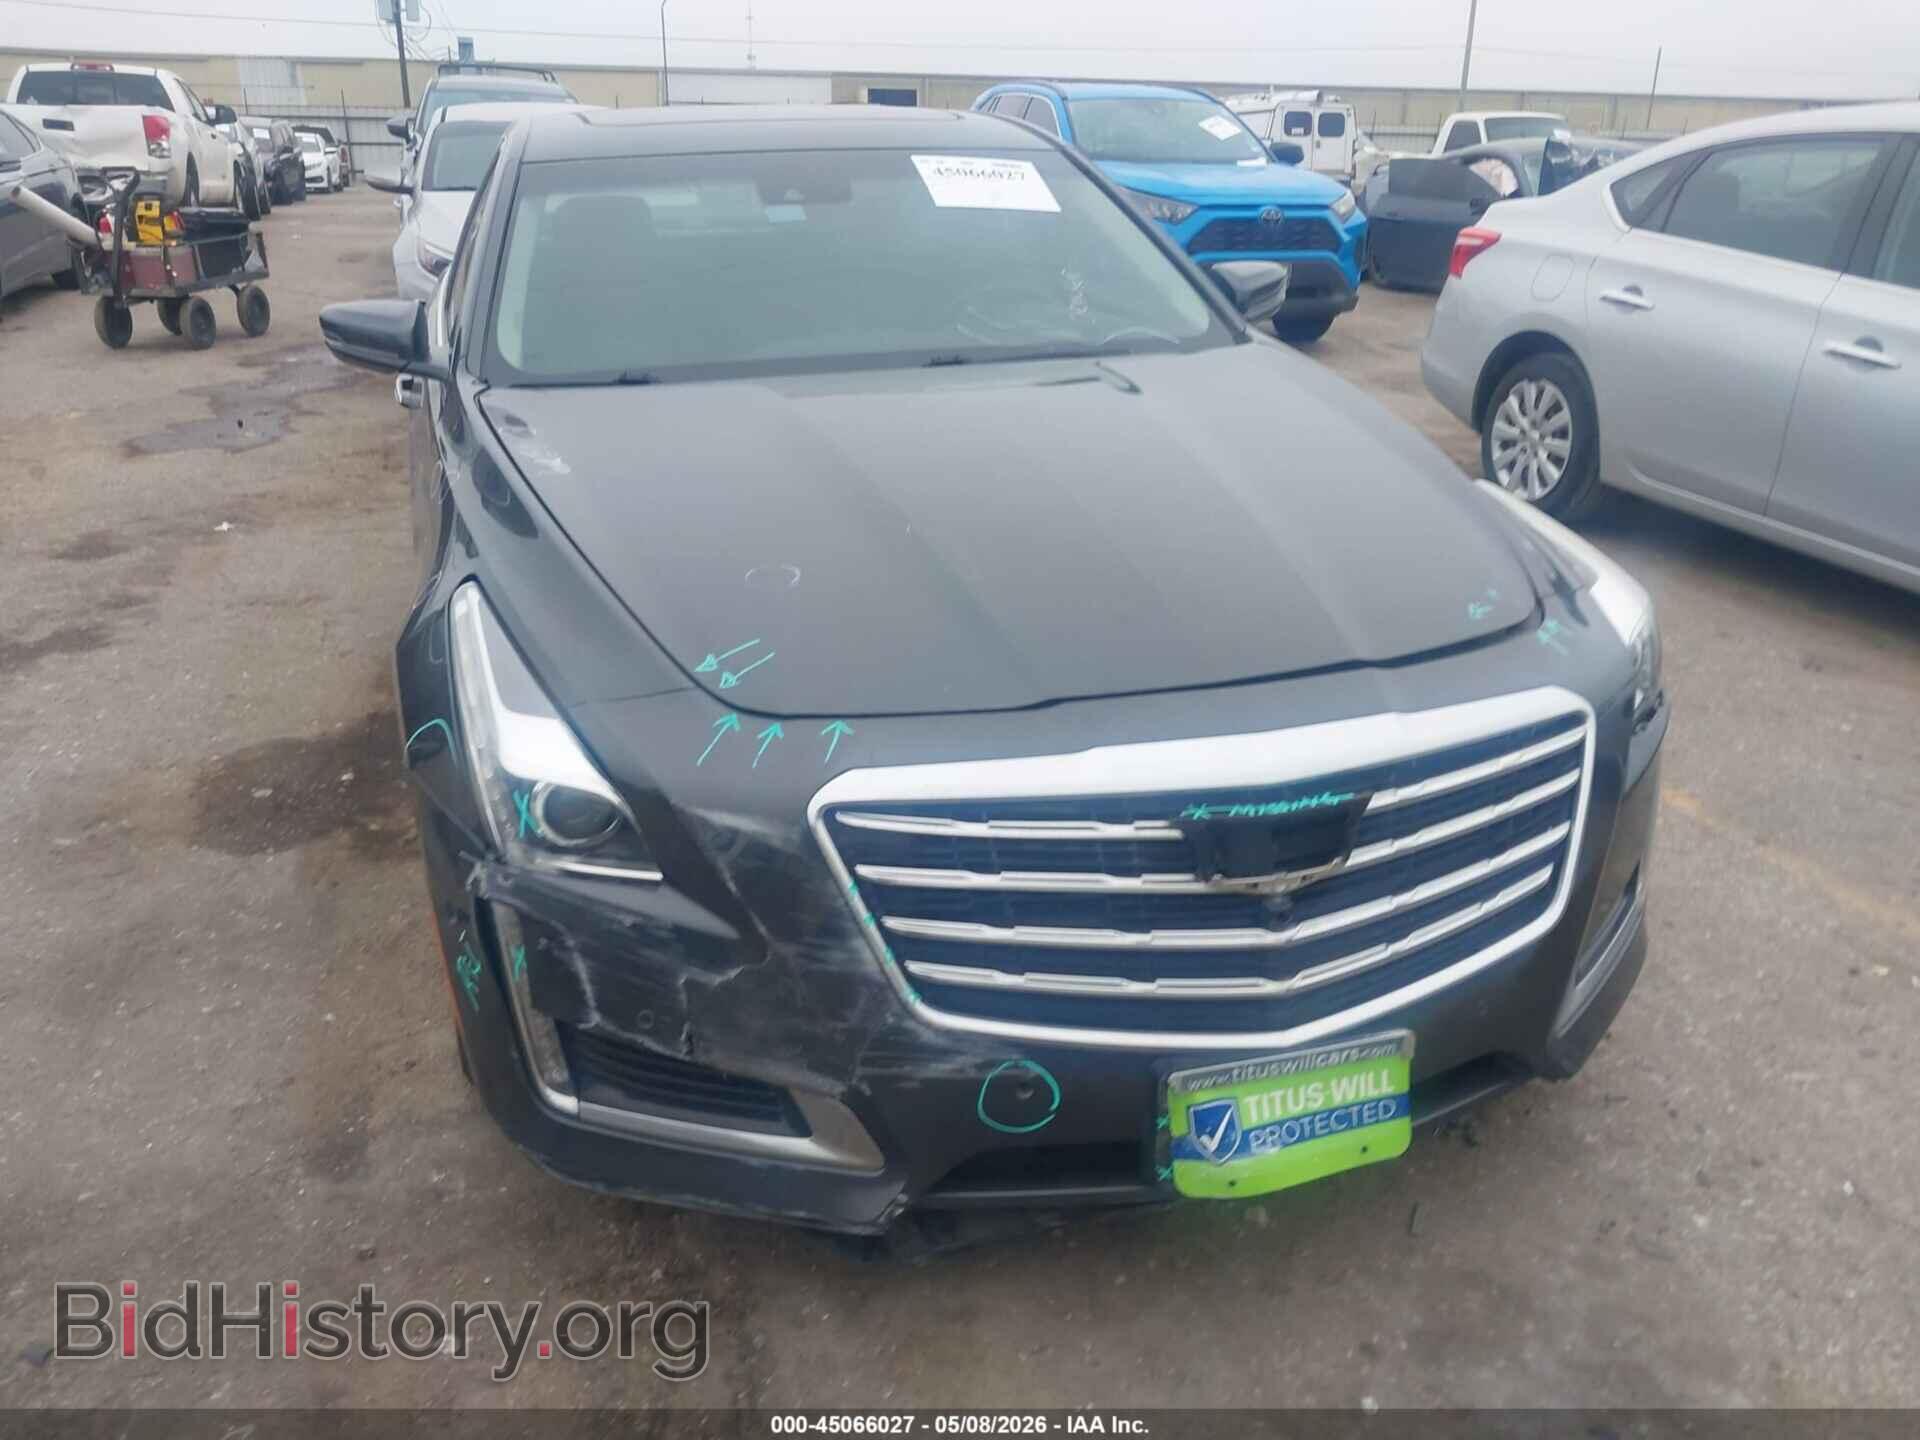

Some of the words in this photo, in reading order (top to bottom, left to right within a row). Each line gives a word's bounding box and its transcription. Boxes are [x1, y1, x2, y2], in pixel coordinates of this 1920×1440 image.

[1247, 1081, 1326, 1122] TITUS
[1331, 1068, 1395, 1105] WILL
[1250, 1098, 1396, 1150] PROTECTED
